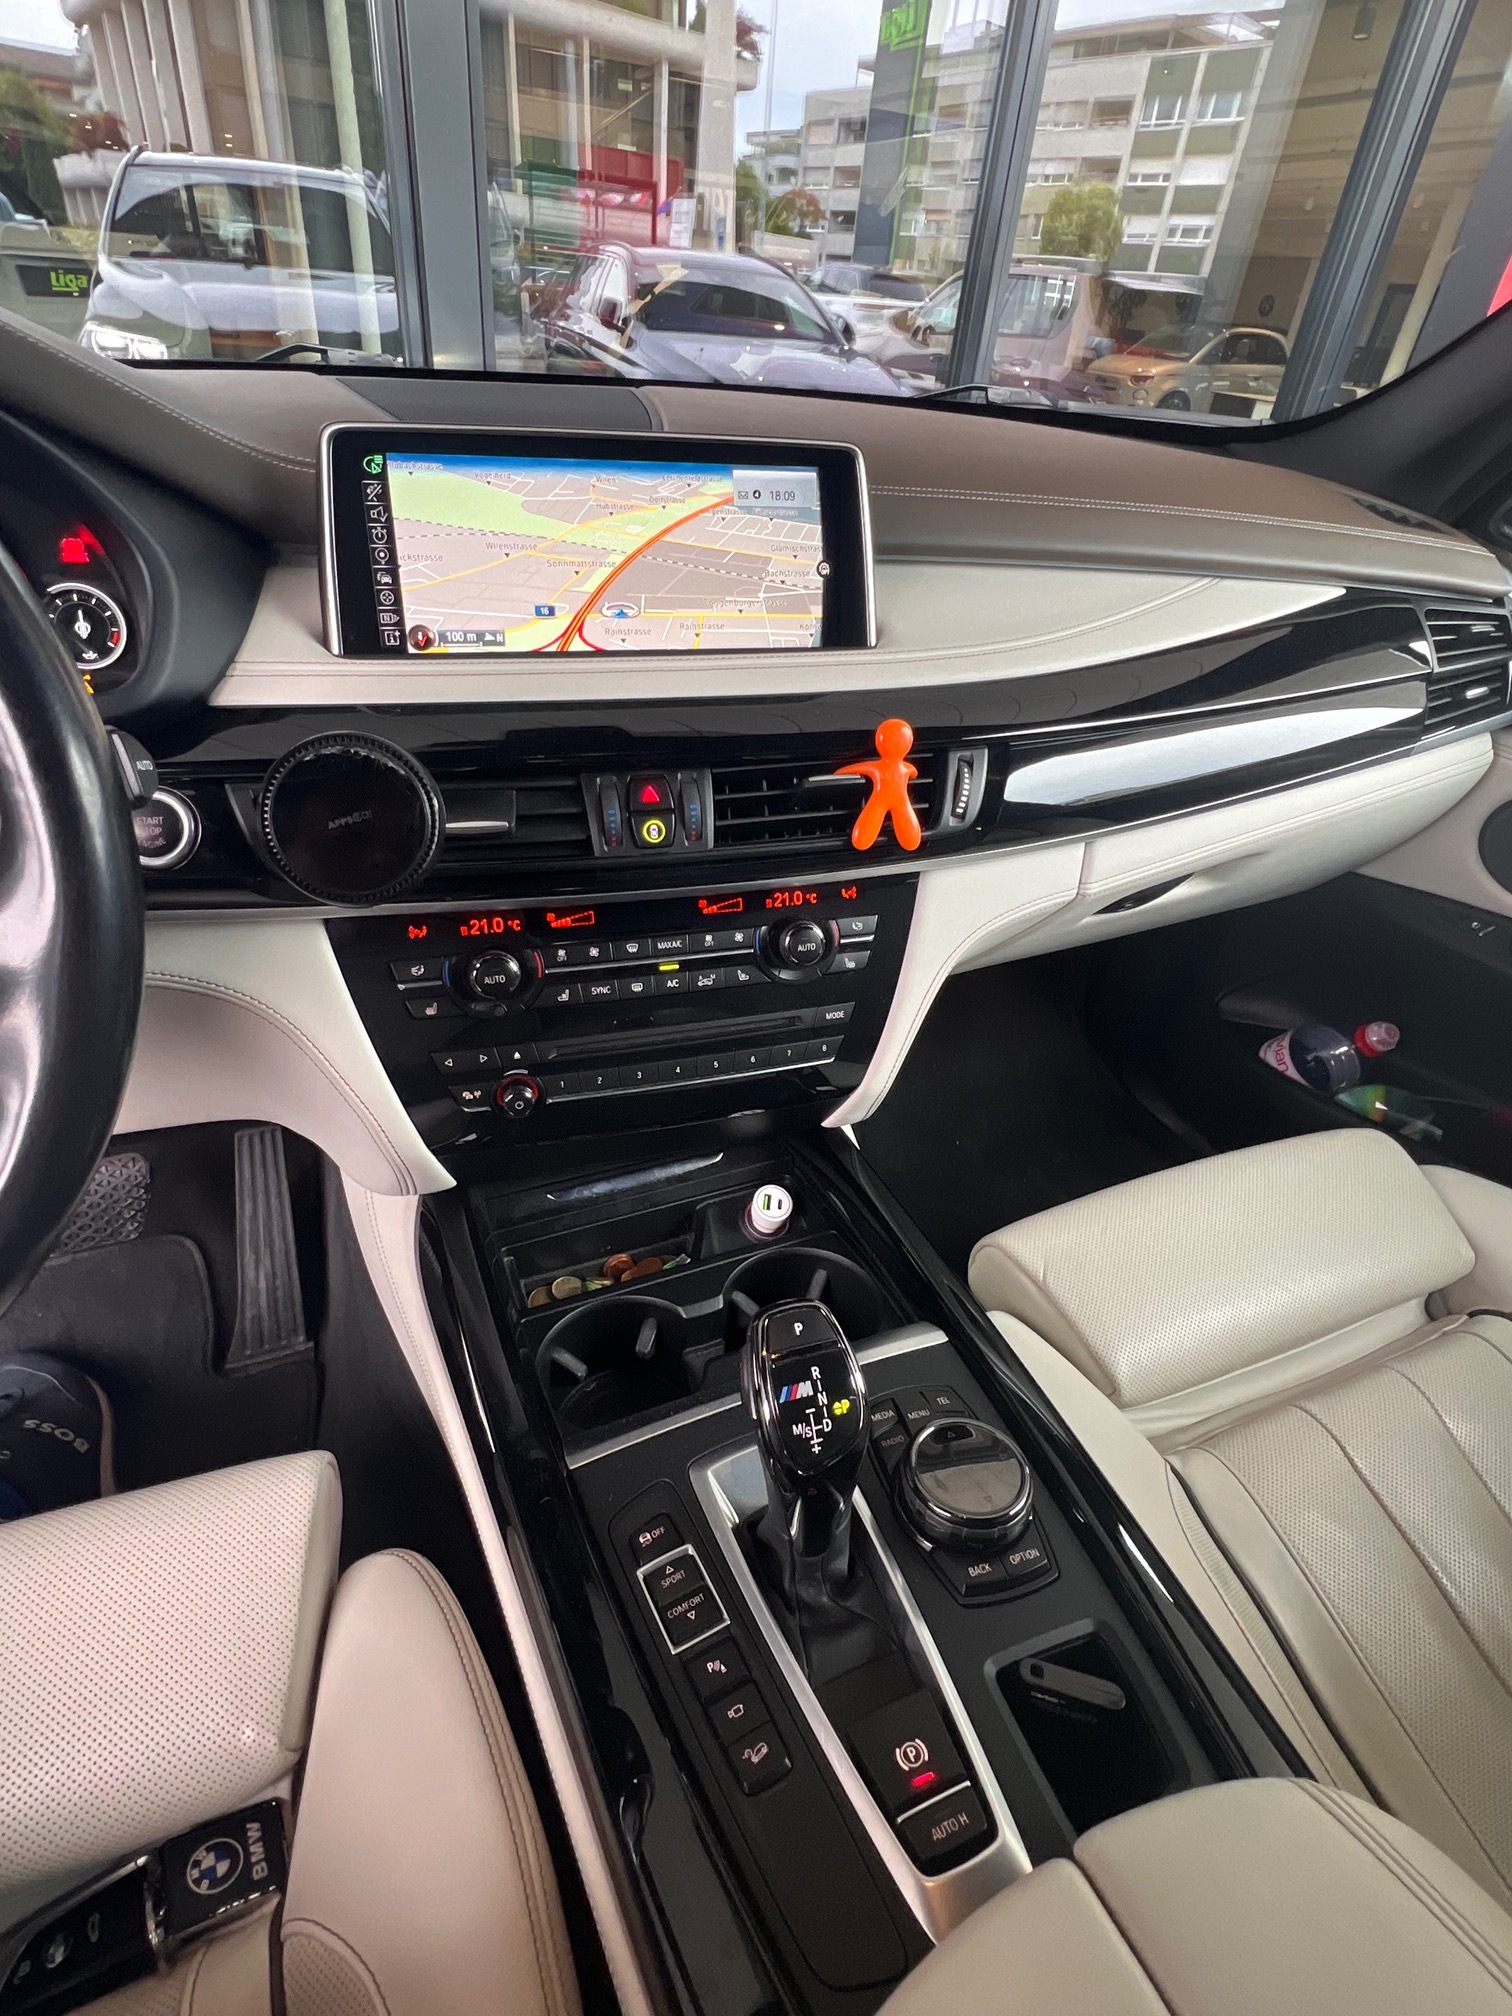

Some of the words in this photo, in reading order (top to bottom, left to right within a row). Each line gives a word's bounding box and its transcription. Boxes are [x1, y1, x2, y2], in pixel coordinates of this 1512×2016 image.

[50, 270, 88, 292] Liga
[485, 542, 538, 551] Wilenstrasse
[547, 559, 617, 569] Sonnmattstrasse
[540, 606, 550, 615] 16
[604, 628, 652, 636] Rainstrasse
[679, 622, 725, 631] Rainstrasse
[445, 632, 465, 642] 100
[466, 634, 477, 642] m
[497, 635, 504, 643] N
[773, 890, 803, 908] 21.0
[470, 917, 504, 935] 21.0
[798, 943, 816, 952] AUTO
[484, 975, 506, 984] AUTO
[667, 979, 680, 988] A/C
[591, 985, 612, 995] SYNC
[825, 1010, 845, 1020] MODE
[793, 1322, 804, 1336] P
[810, 1366, 821, 1380] R
[817, 1391, 828, 1406] N
[936, 1396, 950, 1405] TEL
[870, 1409, 896, 1422] MEDIA
[907, 1408, 930, 1420] MENU
[822, 1419, 832, 1432] D
[22, 1419, 90, 1454] BOSS
[880, 1435, 905, 1448] RADIO
[651, 1526, 666, 1539] OFF
[1009, 1548, 1040, 1565] OPTION
[967, 1562, 992, 1578] BACK
[660, 1569, 686, 1589] SPORT
[667, 1592, 705, 1619] COMFORT
[931, 1817, 959, 1842] AUTO
[957, 1811, 969, 1827] H
[246, 1821, 269, 1881] BMW
